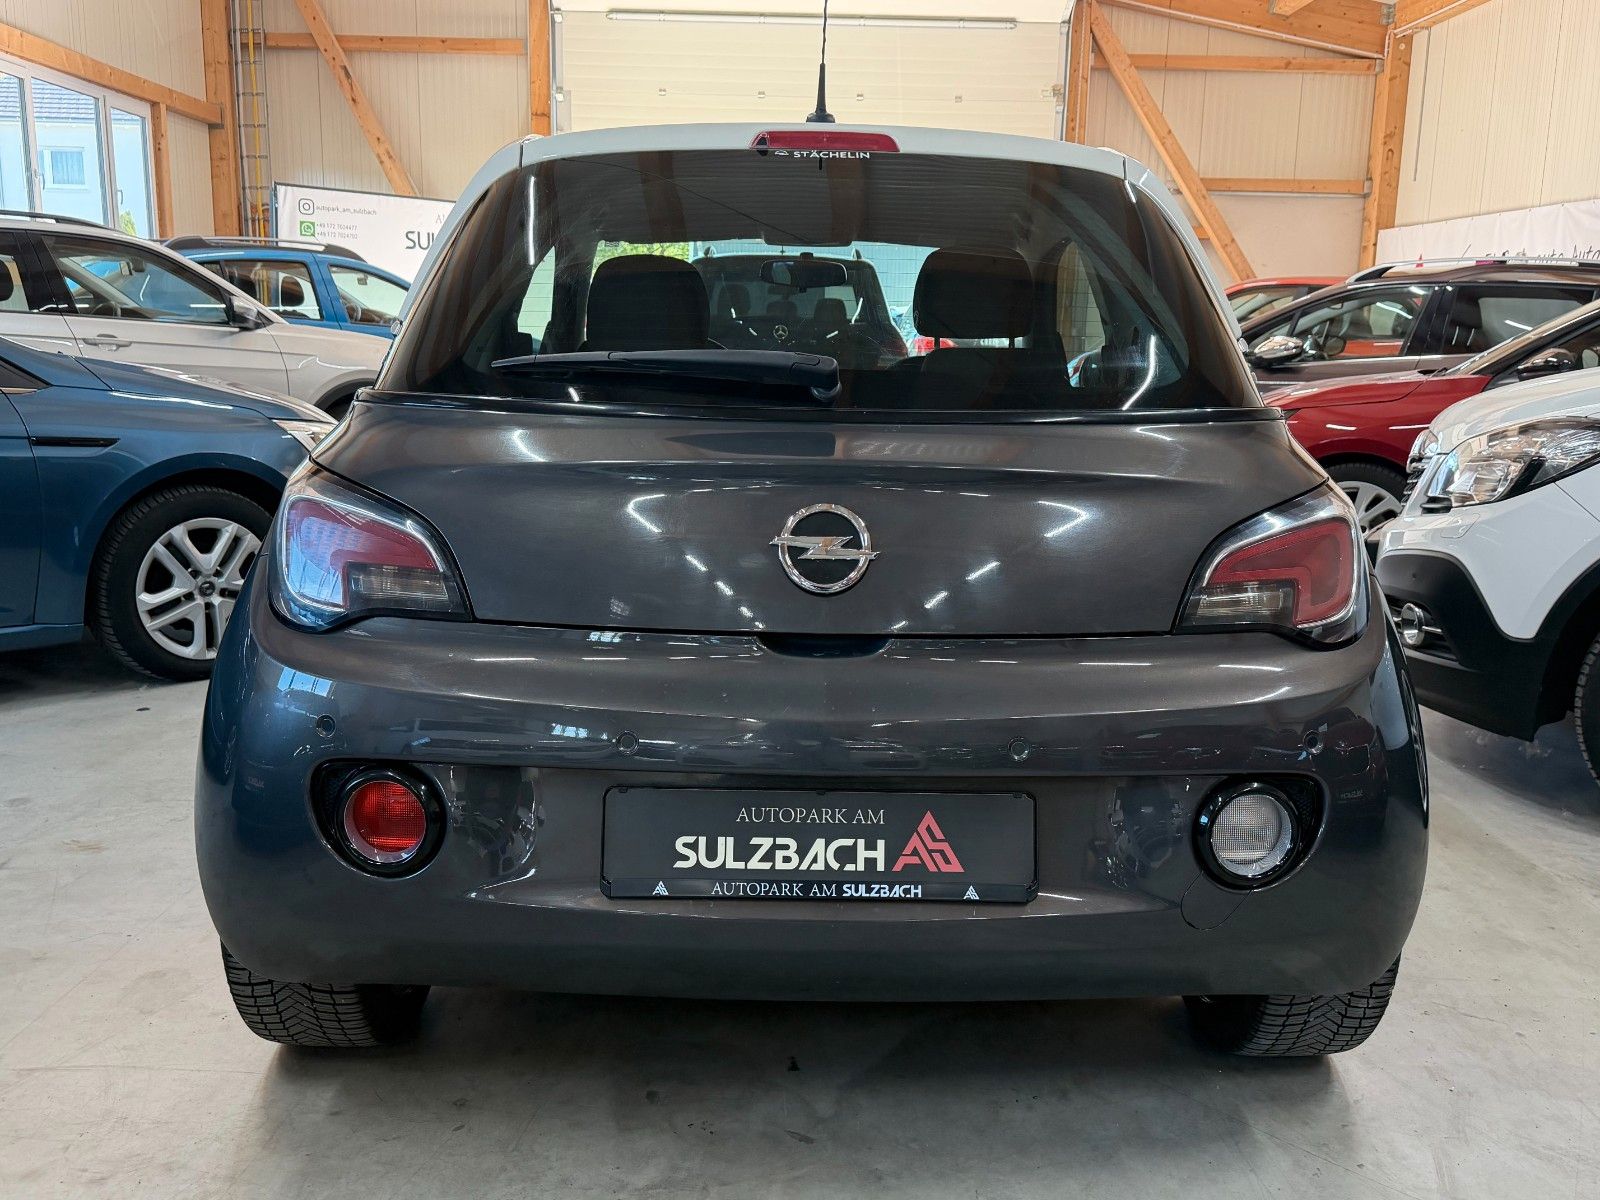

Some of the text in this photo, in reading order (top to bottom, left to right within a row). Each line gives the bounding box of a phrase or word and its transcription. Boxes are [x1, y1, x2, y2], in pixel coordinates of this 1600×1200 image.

[793, 150, 870, 159] STÄCHELIN
[736, 806, 886, 825] AUTOPARK AM
[673, 835, 886, 872] SULZBACH
[710, 881, 804, 897] AUTOPARK
[808, 883, 837, 897] AM
[842, 884, 922, 898] SULZBACH
